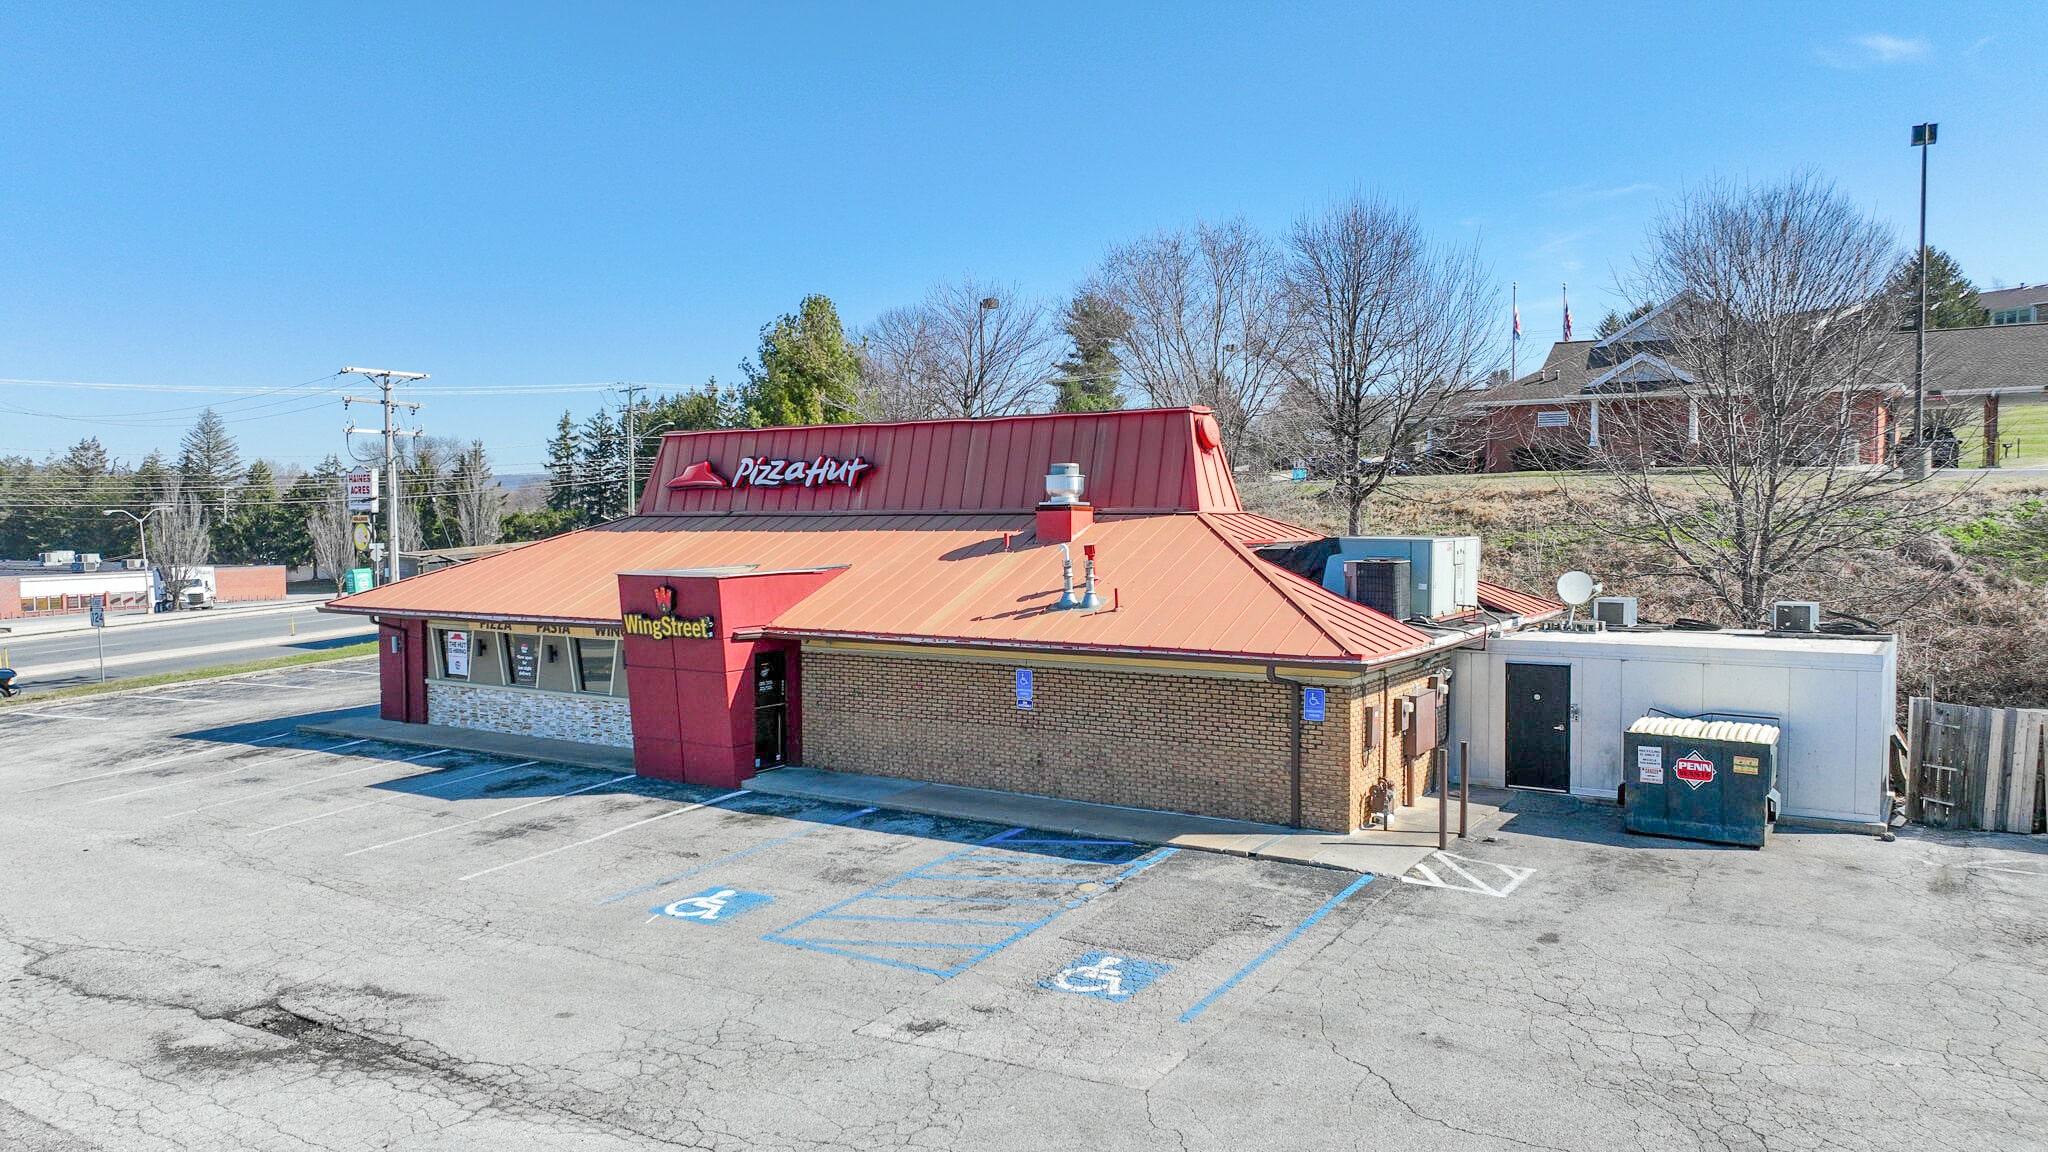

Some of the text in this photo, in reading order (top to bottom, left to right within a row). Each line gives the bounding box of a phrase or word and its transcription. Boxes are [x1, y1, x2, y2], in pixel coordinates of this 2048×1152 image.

[732, 456, 870, 487] Pizza Hut
[349, 474, 370, 482] HAINES
[351, 486, 370, 494] ACRES
[91, 612, 103, 622] 124
[536, 624, 570, 634] PASTA
[595, 626, 624, 637] WIN
[624, 614, 708, 640] WingStreet
[1679, 762, 1711, 772] PENN
